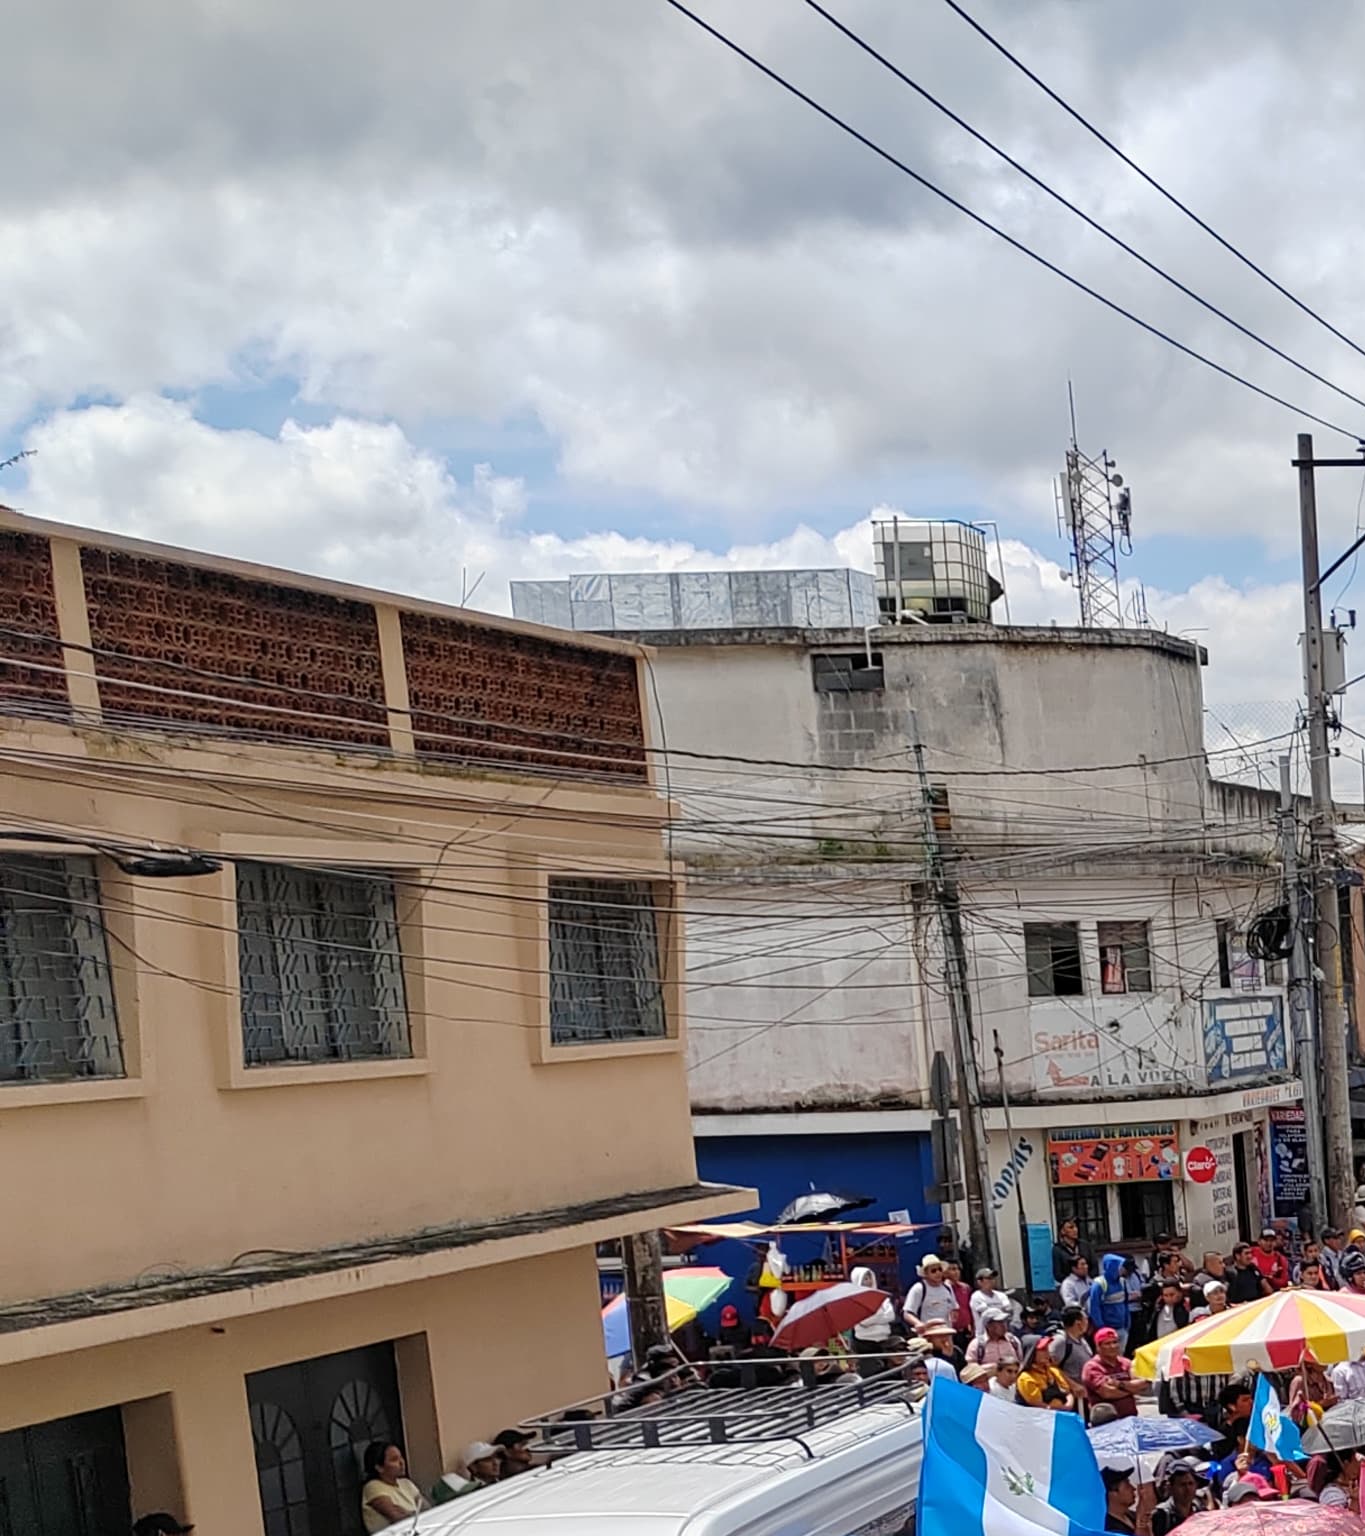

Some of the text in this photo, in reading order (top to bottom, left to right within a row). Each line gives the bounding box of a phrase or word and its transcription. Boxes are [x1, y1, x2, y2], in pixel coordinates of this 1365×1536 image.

[1034, 1030, 1099, 1051] Sarita
[1090, 1074, 1100, 1087] A
[1108, 1072, 1131, 1086] LA
[1187, 1159, 1214, 1171] Claro
